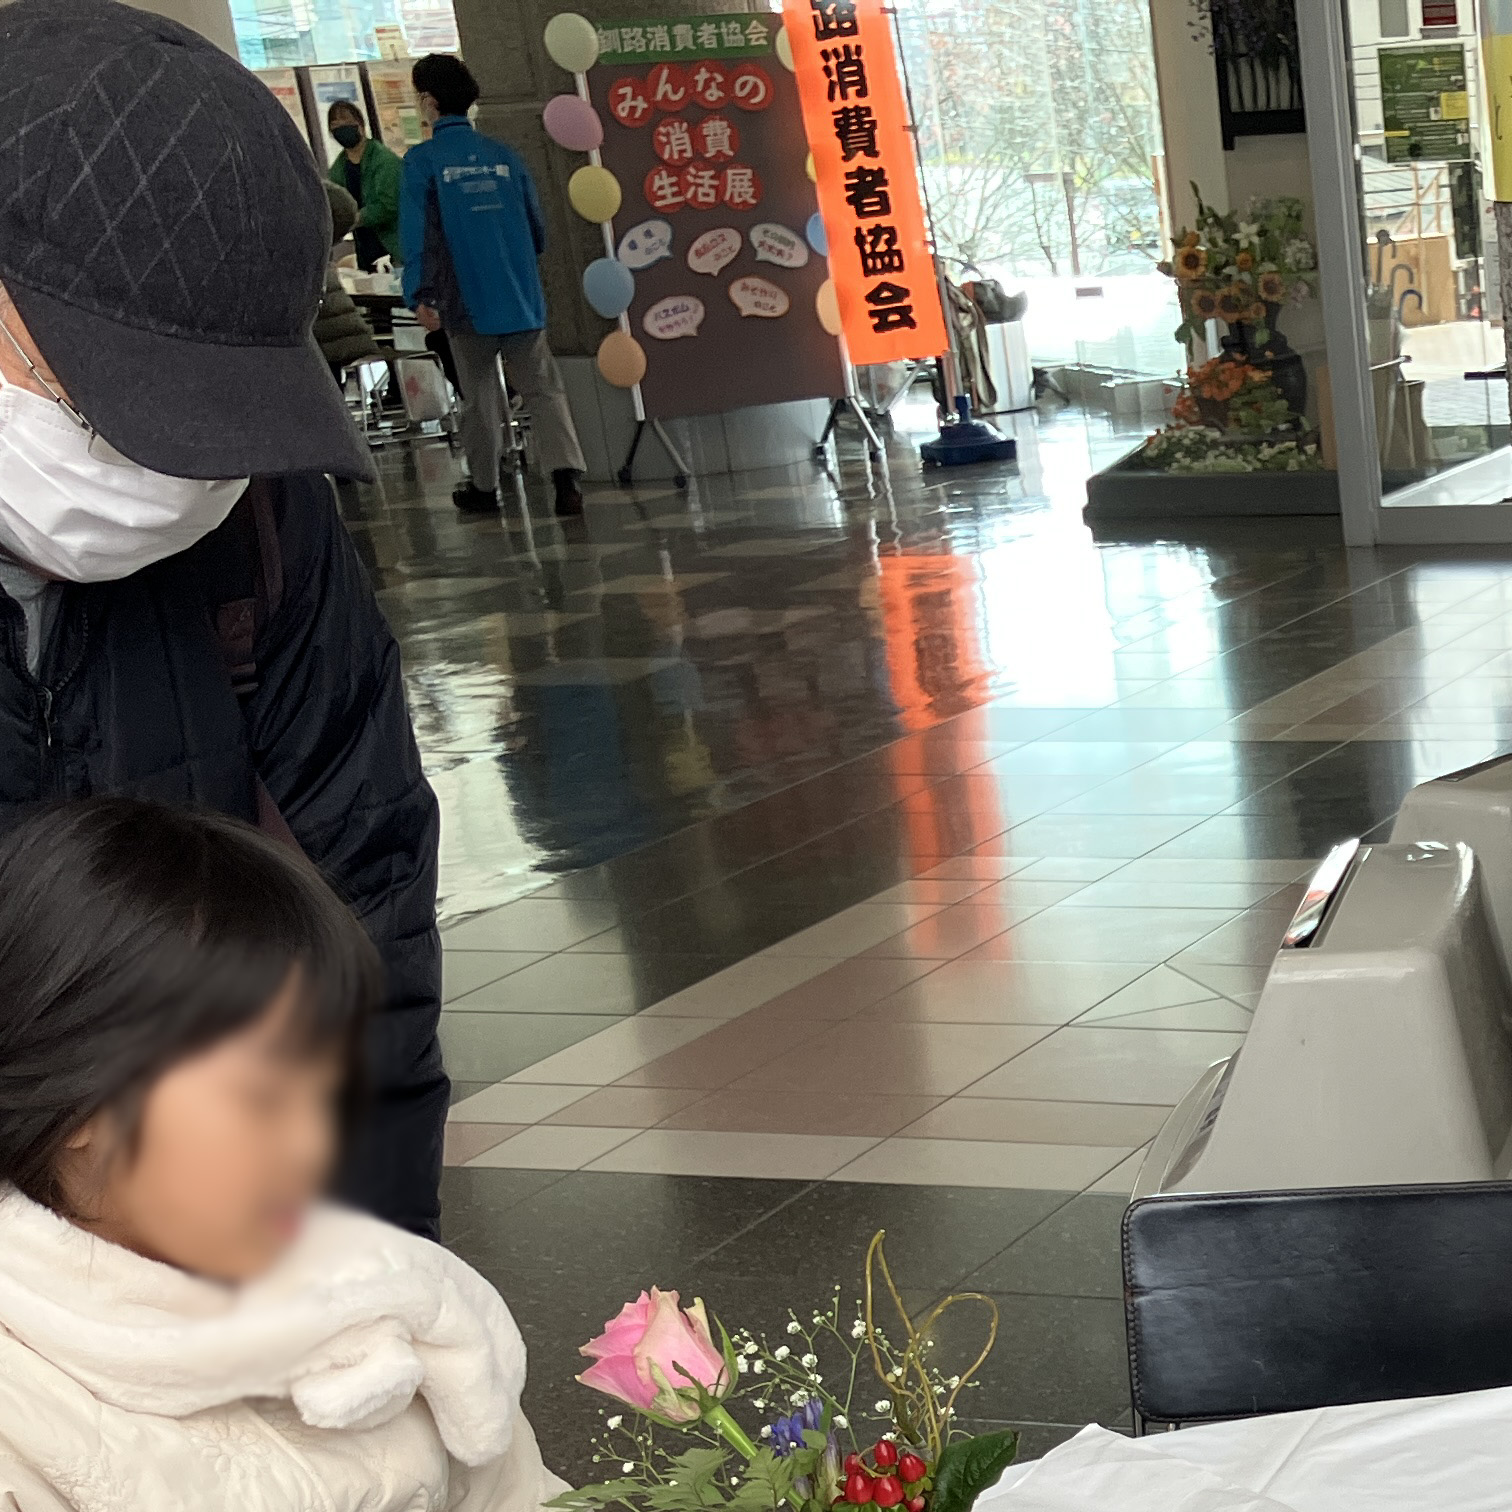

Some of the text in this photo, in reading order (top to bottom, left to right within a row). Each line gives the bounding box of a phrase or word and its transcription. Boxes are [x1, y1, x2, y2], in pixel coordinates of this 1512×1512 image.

[597, 20, 769, 53] 釧路消費者協会
[616, 67, 767, 119] みんなの
[658, 120, 734, 159] 消費
[653, 167, 758, 207] 生活展
[810, 0, 917, 334] 路消費者協会
